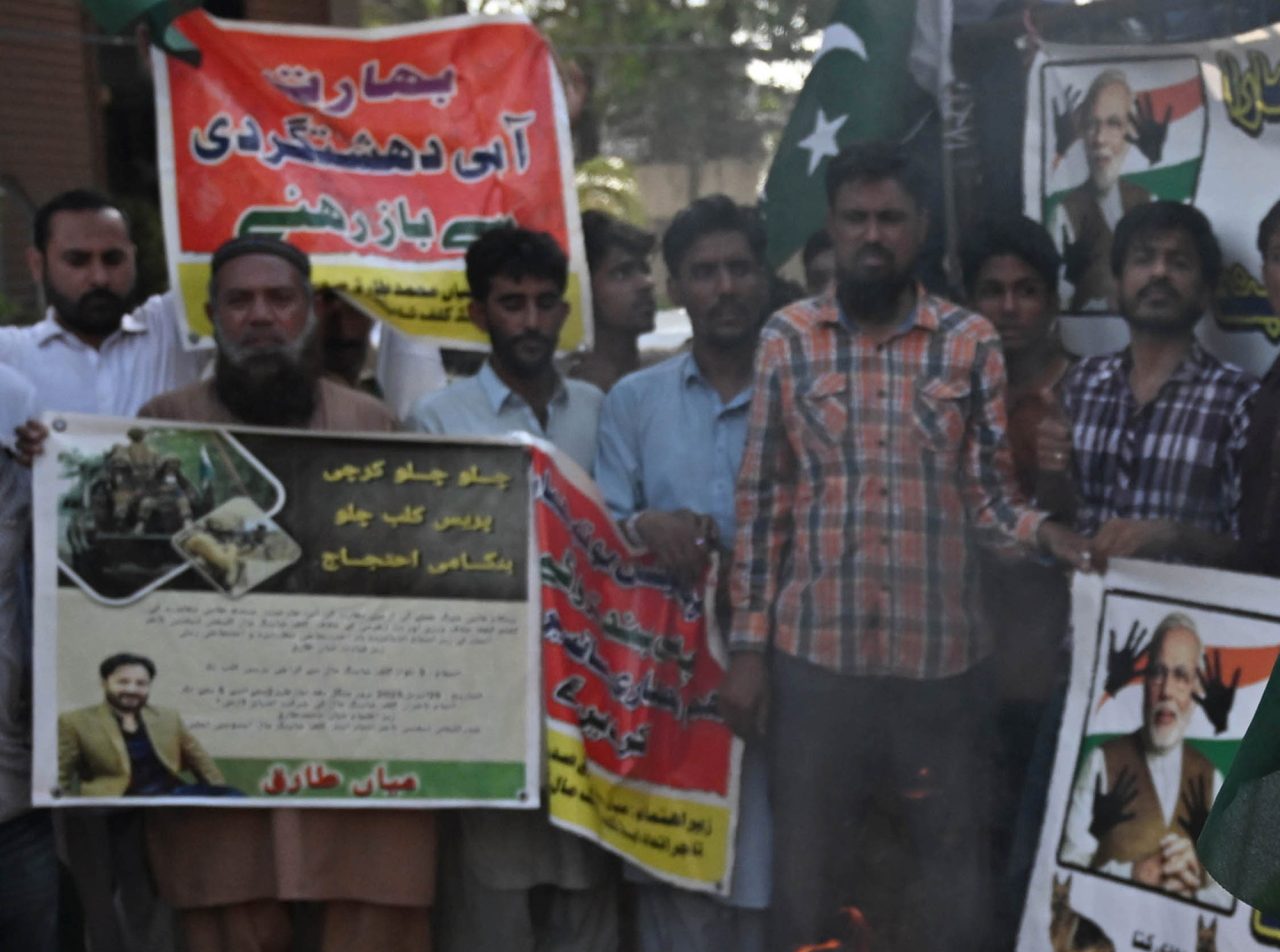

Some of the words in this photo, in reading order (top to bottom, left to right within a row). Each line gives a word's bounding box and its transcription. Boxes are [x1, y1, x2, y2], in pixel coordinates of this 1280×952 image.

[263, 60, 458, 116] بھارت
[335, 502, 374, 528] چلو
[382, 504, 426, 528] کلب
[321, 546, 419, 573] احتجاج
[260, 764, 342, 796] طارق
[350, 766, 418, 797] میاں
